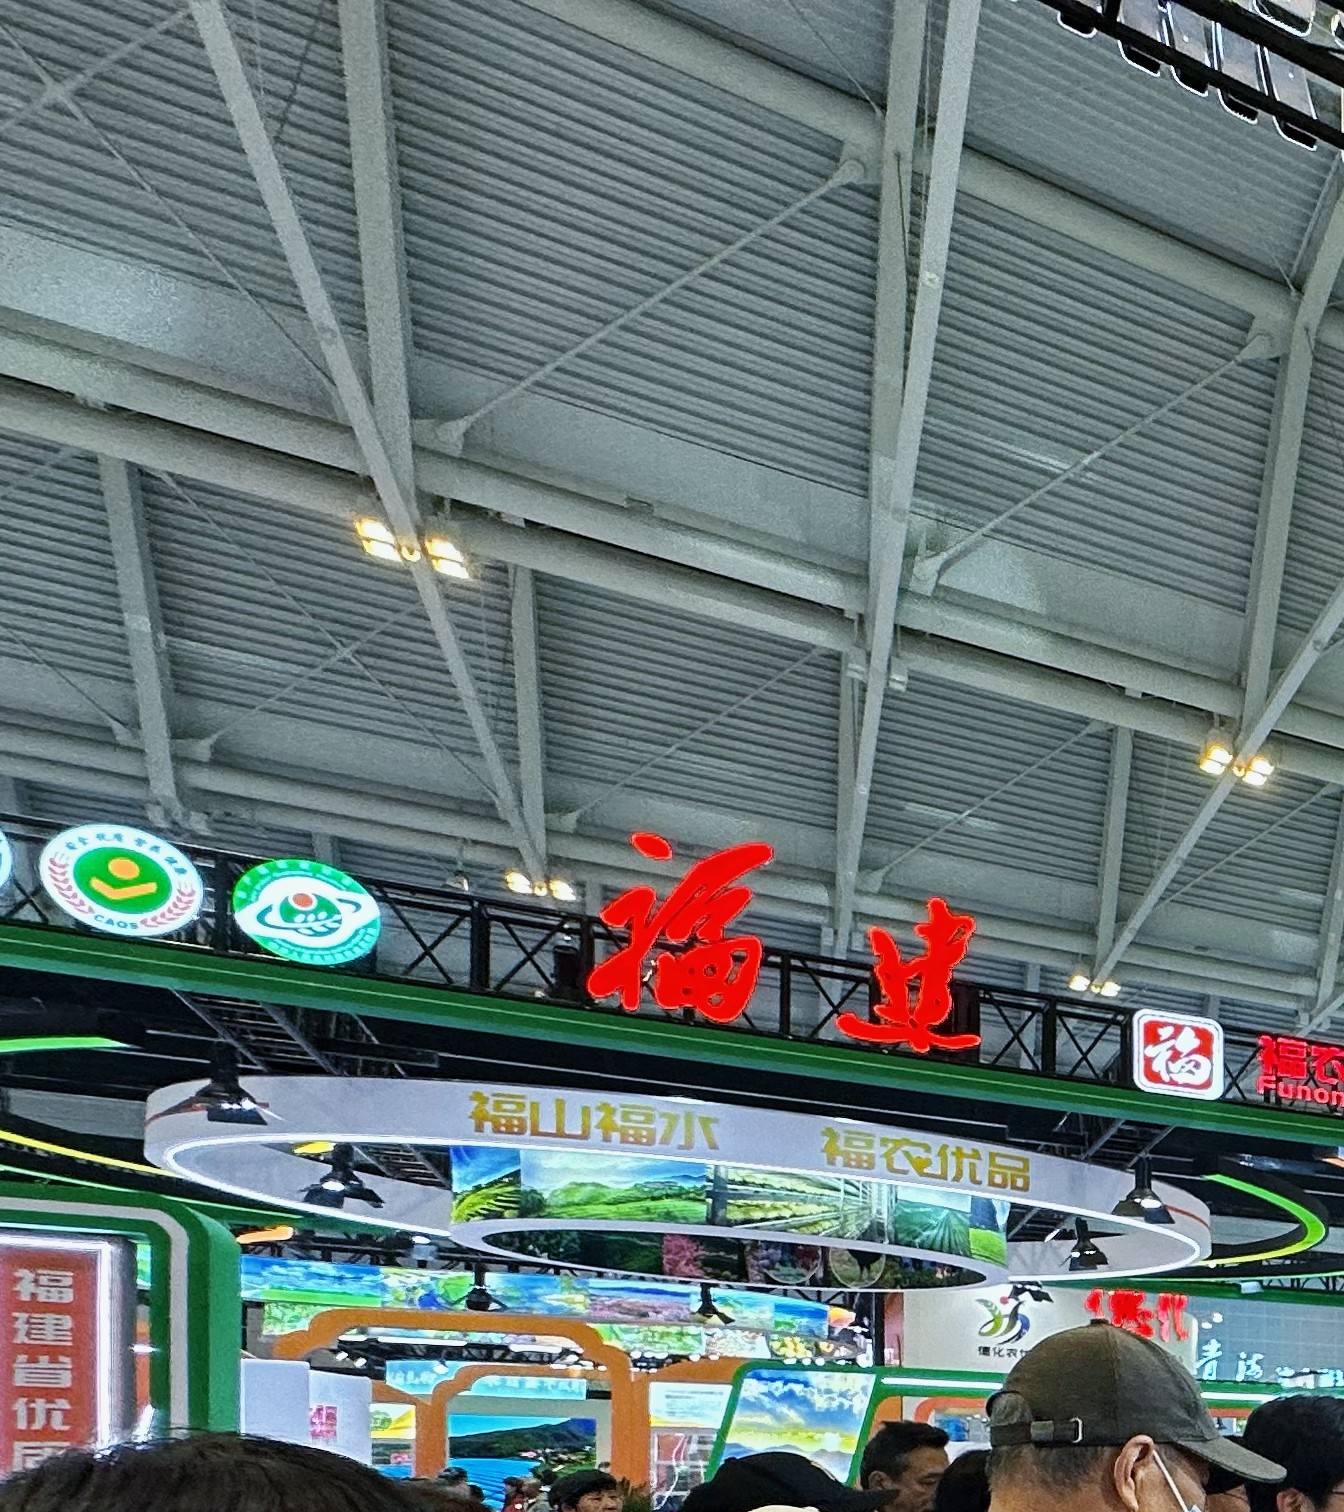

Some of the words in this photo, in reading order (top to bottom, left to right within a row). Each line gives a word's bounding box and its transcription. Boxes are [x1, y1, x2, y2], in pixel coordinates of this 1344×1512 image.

[587, 831, 981, 1053] 福建
[468, 1090, 719, 1151] 福山福水
[820, 1126, 1031, 1193] 福农优品
